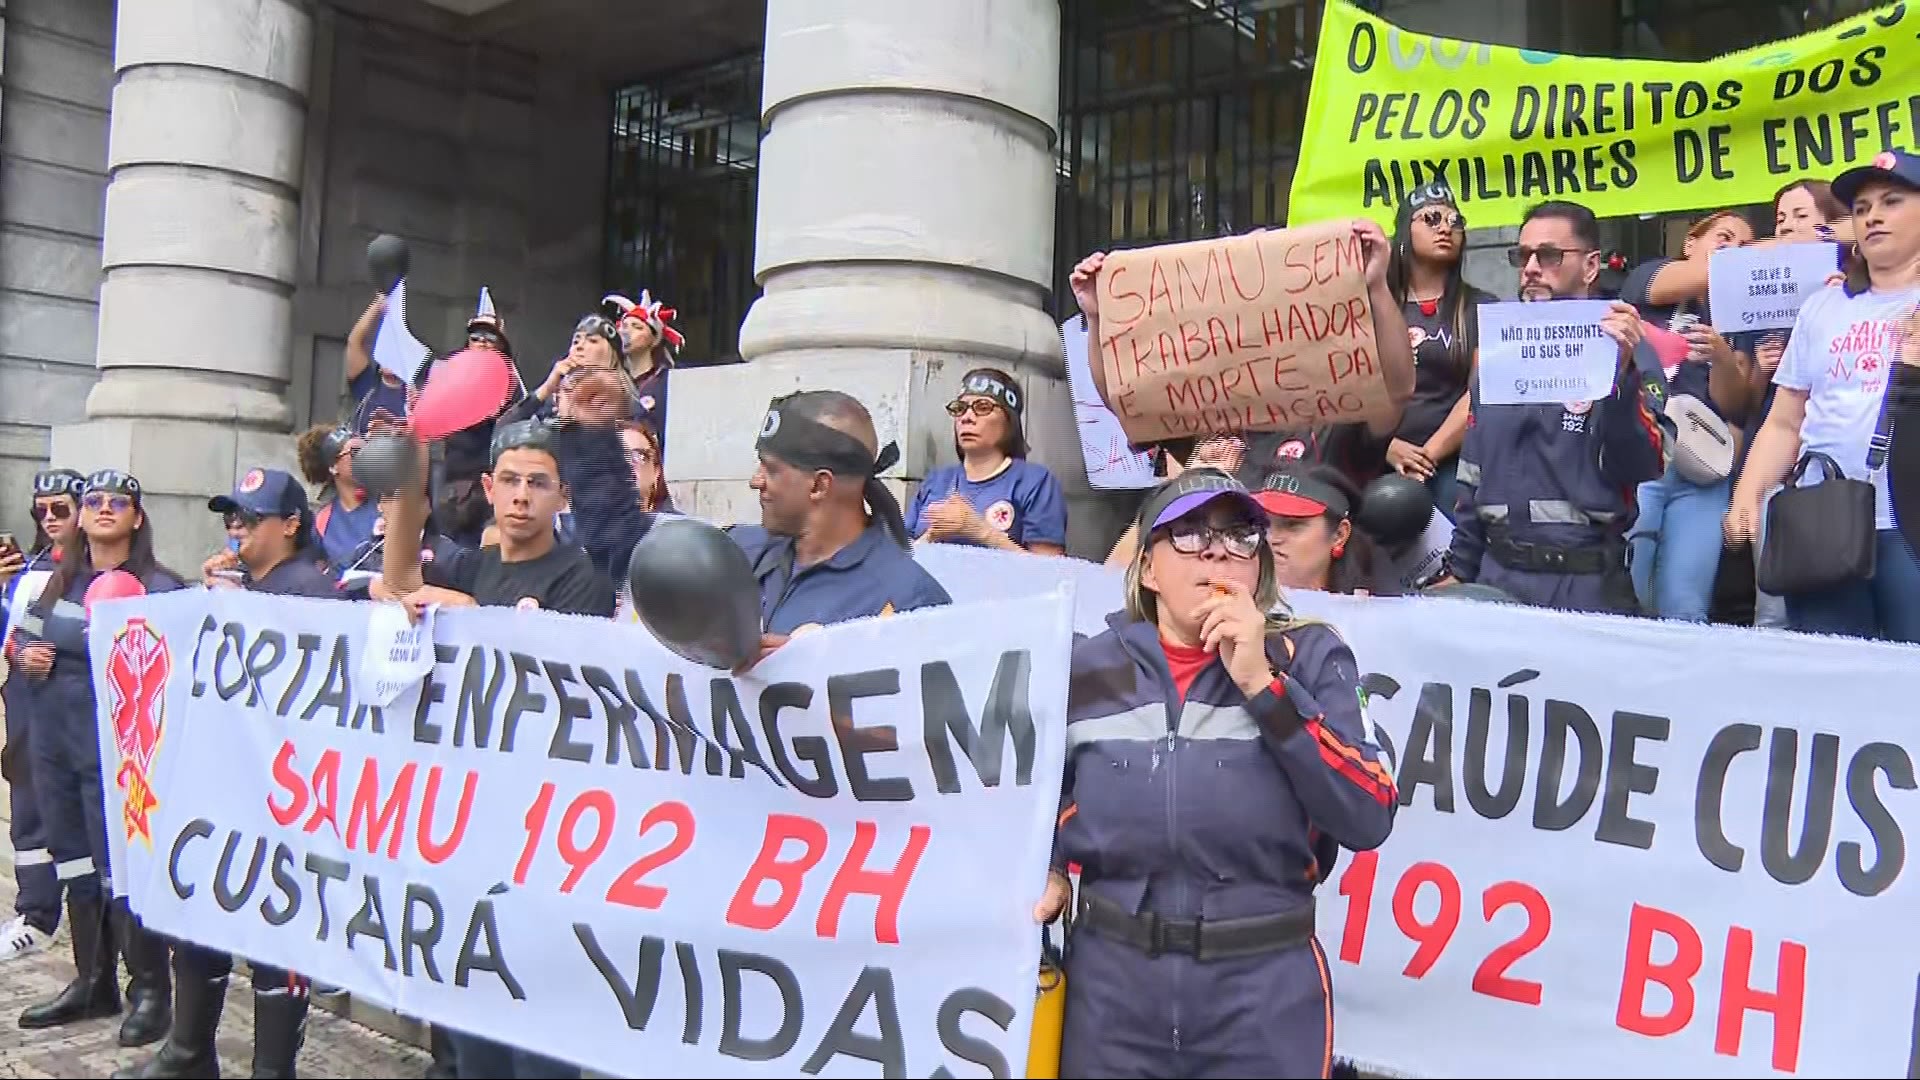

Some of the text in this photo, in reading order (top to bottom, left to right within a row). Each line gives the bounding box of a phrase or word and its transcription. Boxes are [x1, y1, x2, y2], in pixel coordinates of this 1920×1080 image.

[1347, 21, 1377, 74] O
[1349, 45, 1886, 143] PELOS DIREITOS DOS
[1674, 123, 1735, 183] DE
[1108, 233, 1367, 325] SAMU SEM
[1748, 283, 1778, 297] SAMU
[1750, 267, 1782, 282] SALVE
[1500, 325, 1523, 342] NÃO
[1544, 323, 1604, 340] DESMONTE
[1756, 307, 1800, 321] SINDIB
[1165, 354, 1311, 412] MORTE
[1327, 346, 1374, 385] DA
[1540, 343, 1561, 359] SUS
[1560, 420, 1585, 433] 192
[413, 643, 1037, 801] ENFERMAGEM
[267, 739, 931, 943] SAMU 192 BH
[168, 818, 1016, 1079] CUSTARÁ VIDAS
[1337, 849, 1807, 1073] 192 BH
